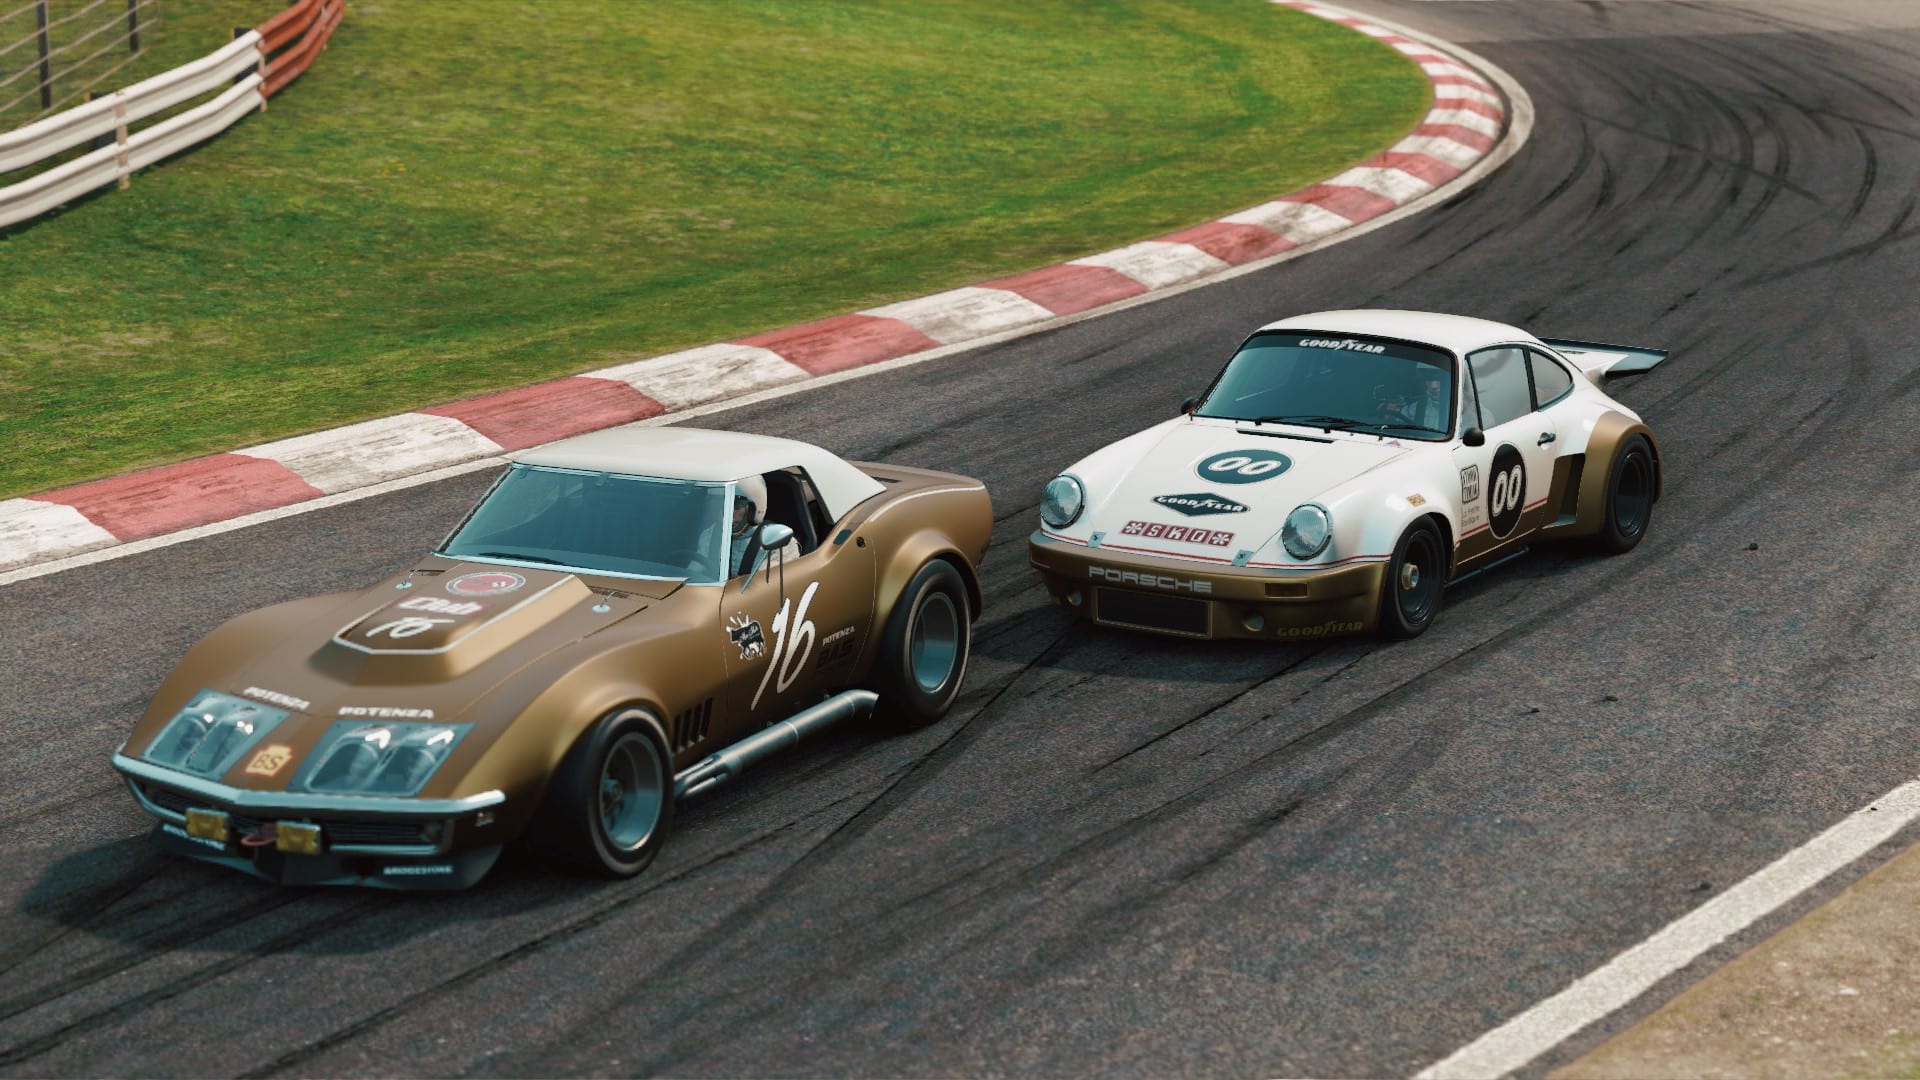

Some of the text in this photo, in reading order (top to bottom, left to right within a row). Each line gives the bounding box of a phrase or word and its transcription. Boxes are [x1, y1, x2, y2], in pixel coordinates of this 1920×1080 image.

[1298, 339, 1386, 354] GOODYEAR
[1207, 456, 1283, 476] 00
[1491, 464, 1523, 518] 00
[1155, 495, 1246, 514] GOODYEAR
[1088, 566, 1213, 593] PORSCHE
[822, 625, 855, 647] POTENZA
[1276, 619, 1365, 638] GOODYEAR
[751, 581, 820, 711] 16
[243, 685, 311, 710] POTENZA
[338, 705, 435, 720] POTENZA
[252, 754, 284, 771] BS
